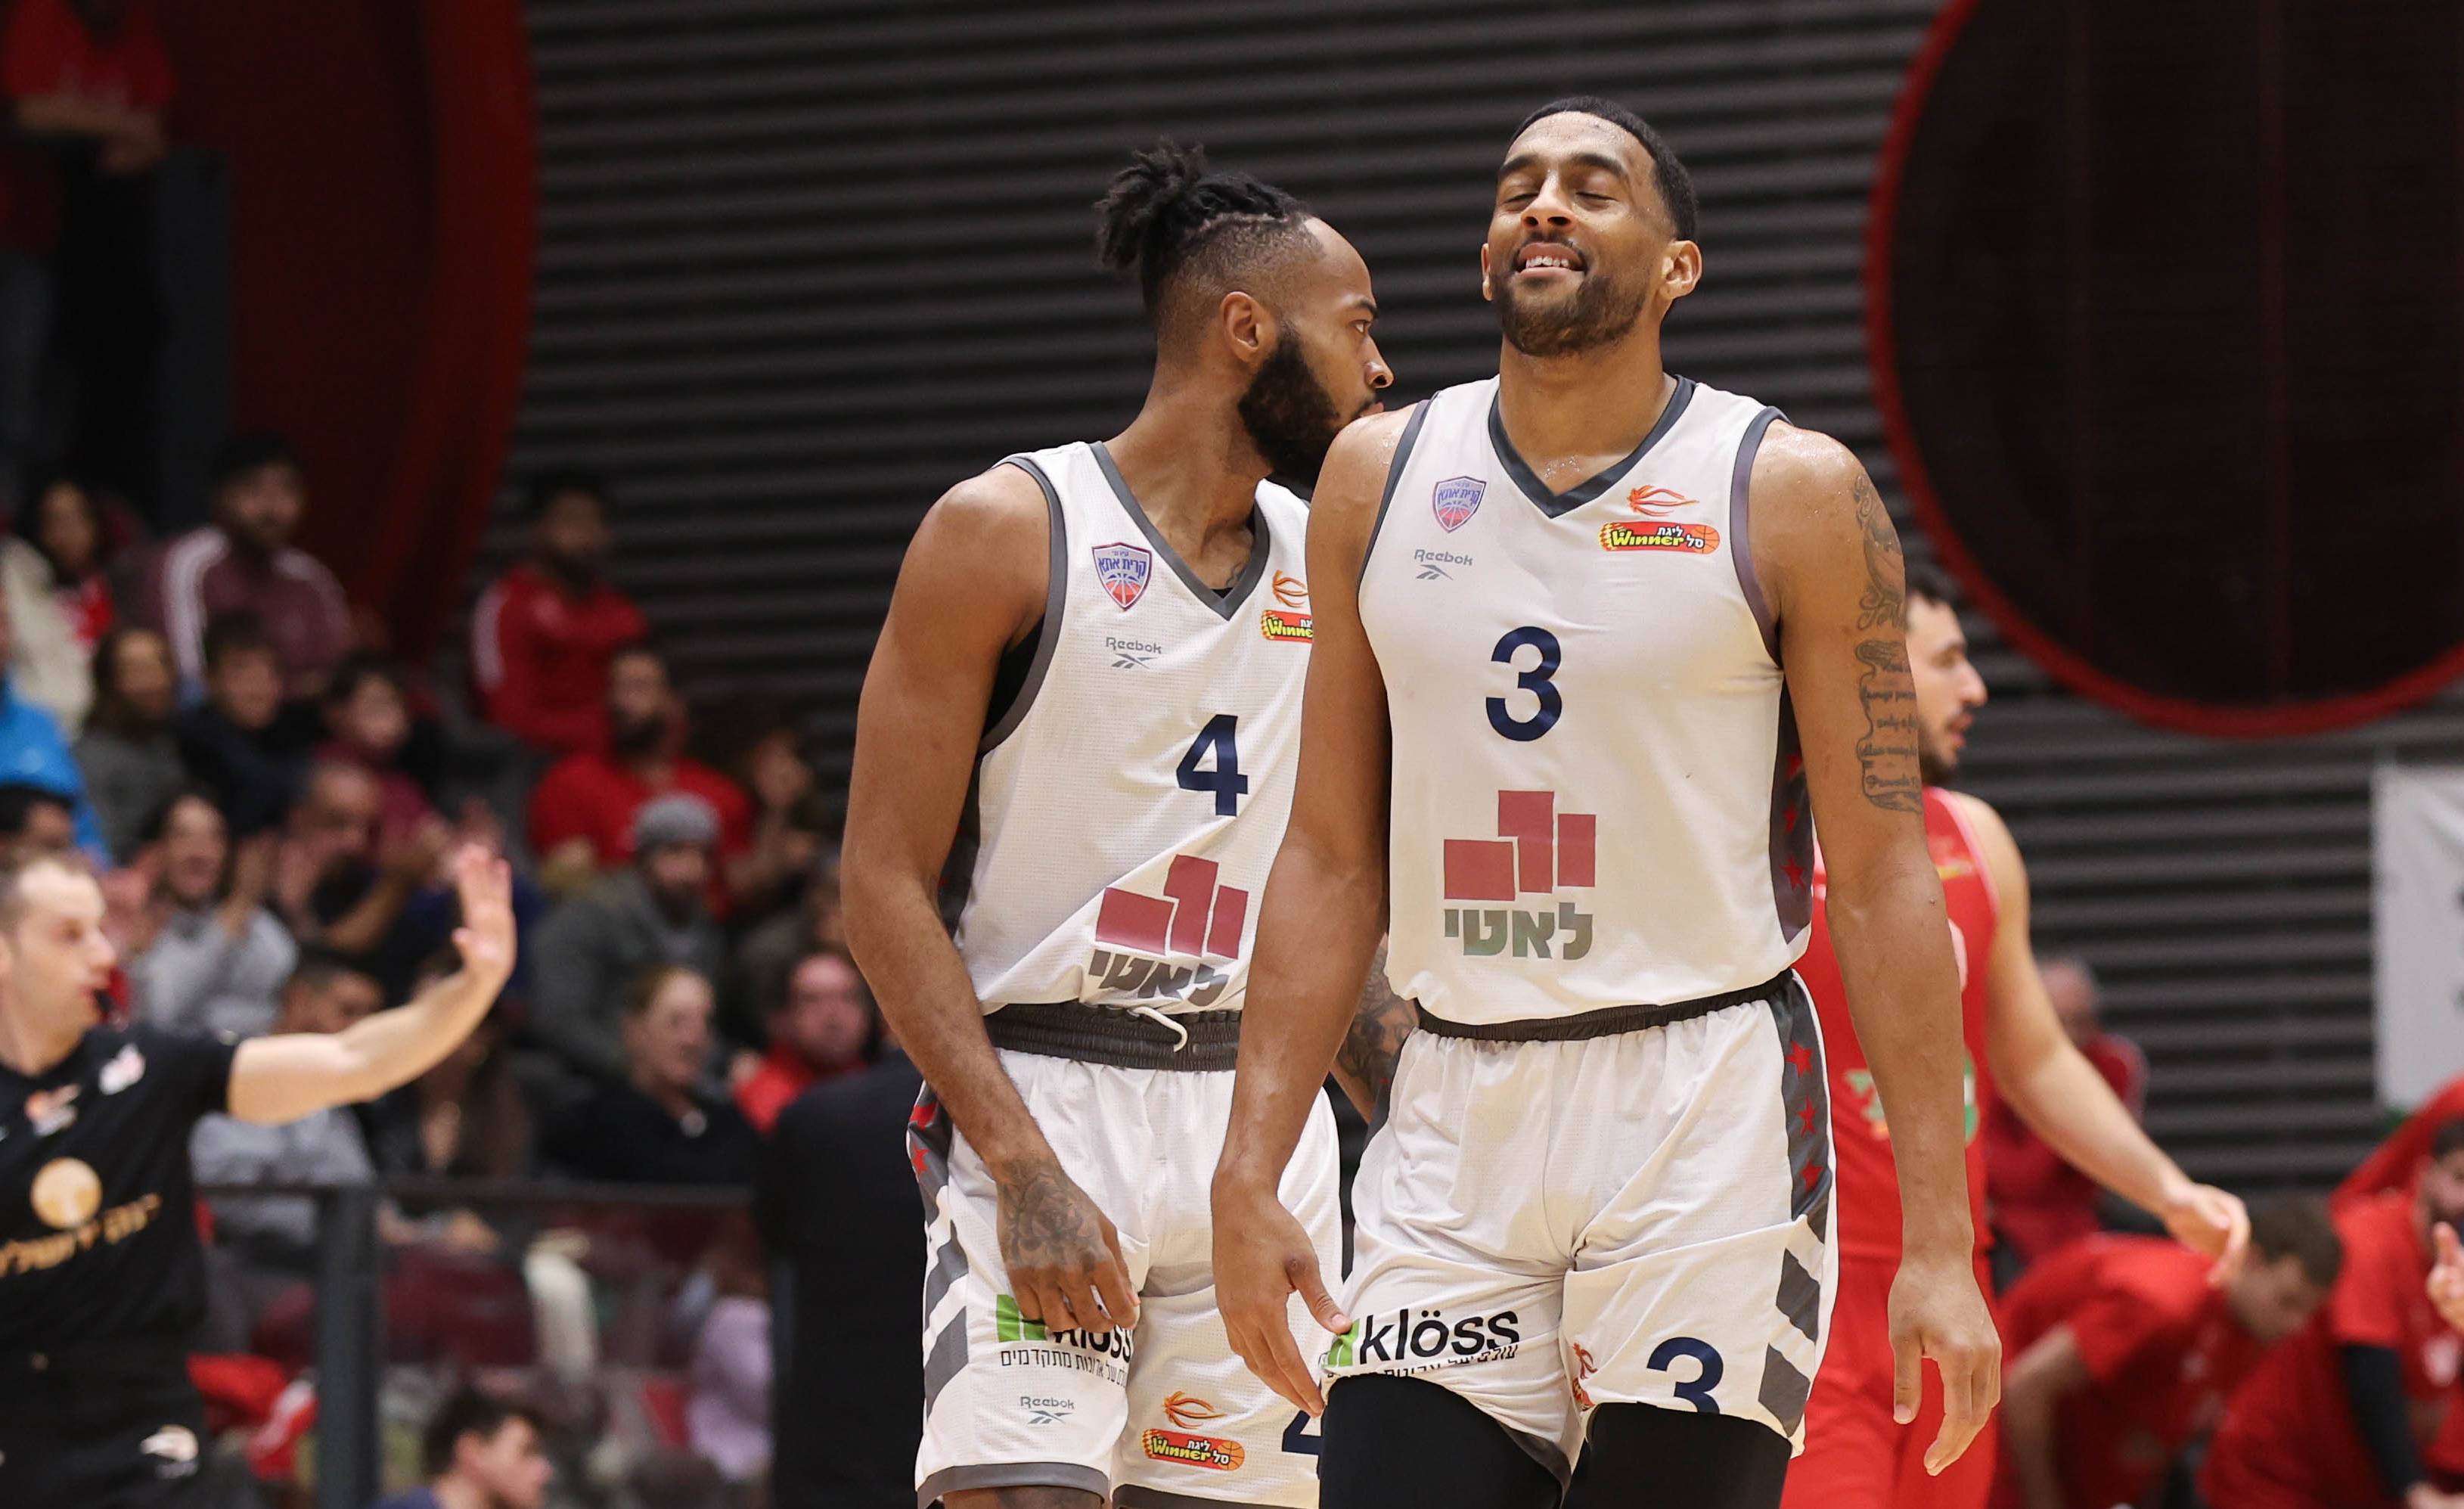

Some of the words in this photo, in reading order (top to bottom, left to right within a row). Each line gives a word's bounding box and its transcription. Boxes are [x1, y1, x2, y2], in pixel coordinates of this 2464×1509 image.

[1611, 529, 1685, 547] Winner
[1686, 534, 1705, 548] סל
[1657, 525, 1684, 537] ליגת
[1098, 557, 1120, 576] אתא
[1414, 548, 1473, 567] Reebok
[1122, 558, 1147, 579] קרית
[1266, 617, 1313, 638] Winne
[1106, 637, 1162, 654] Reebok
[1485, 626, 1562, 742] 3
[1176, 714, 1248, 816] 4
[1444, 902, 1593, 960] לאטי
[1088, 949, 1230, 1007] לאטי
[1359, 1309, 1520, 1365] klöss
[1001, 1349, 1072, 1368] מתקדמים
[1646, 1336, 1724, 1414] 3
[1020, 1396, 1075, 1410] Reebok
[1152, 1436, 1212, 1461] Winner
[1212, 1450, 1230, 1464] סל
[1187, 1439, 1212, 1452] ליגת
